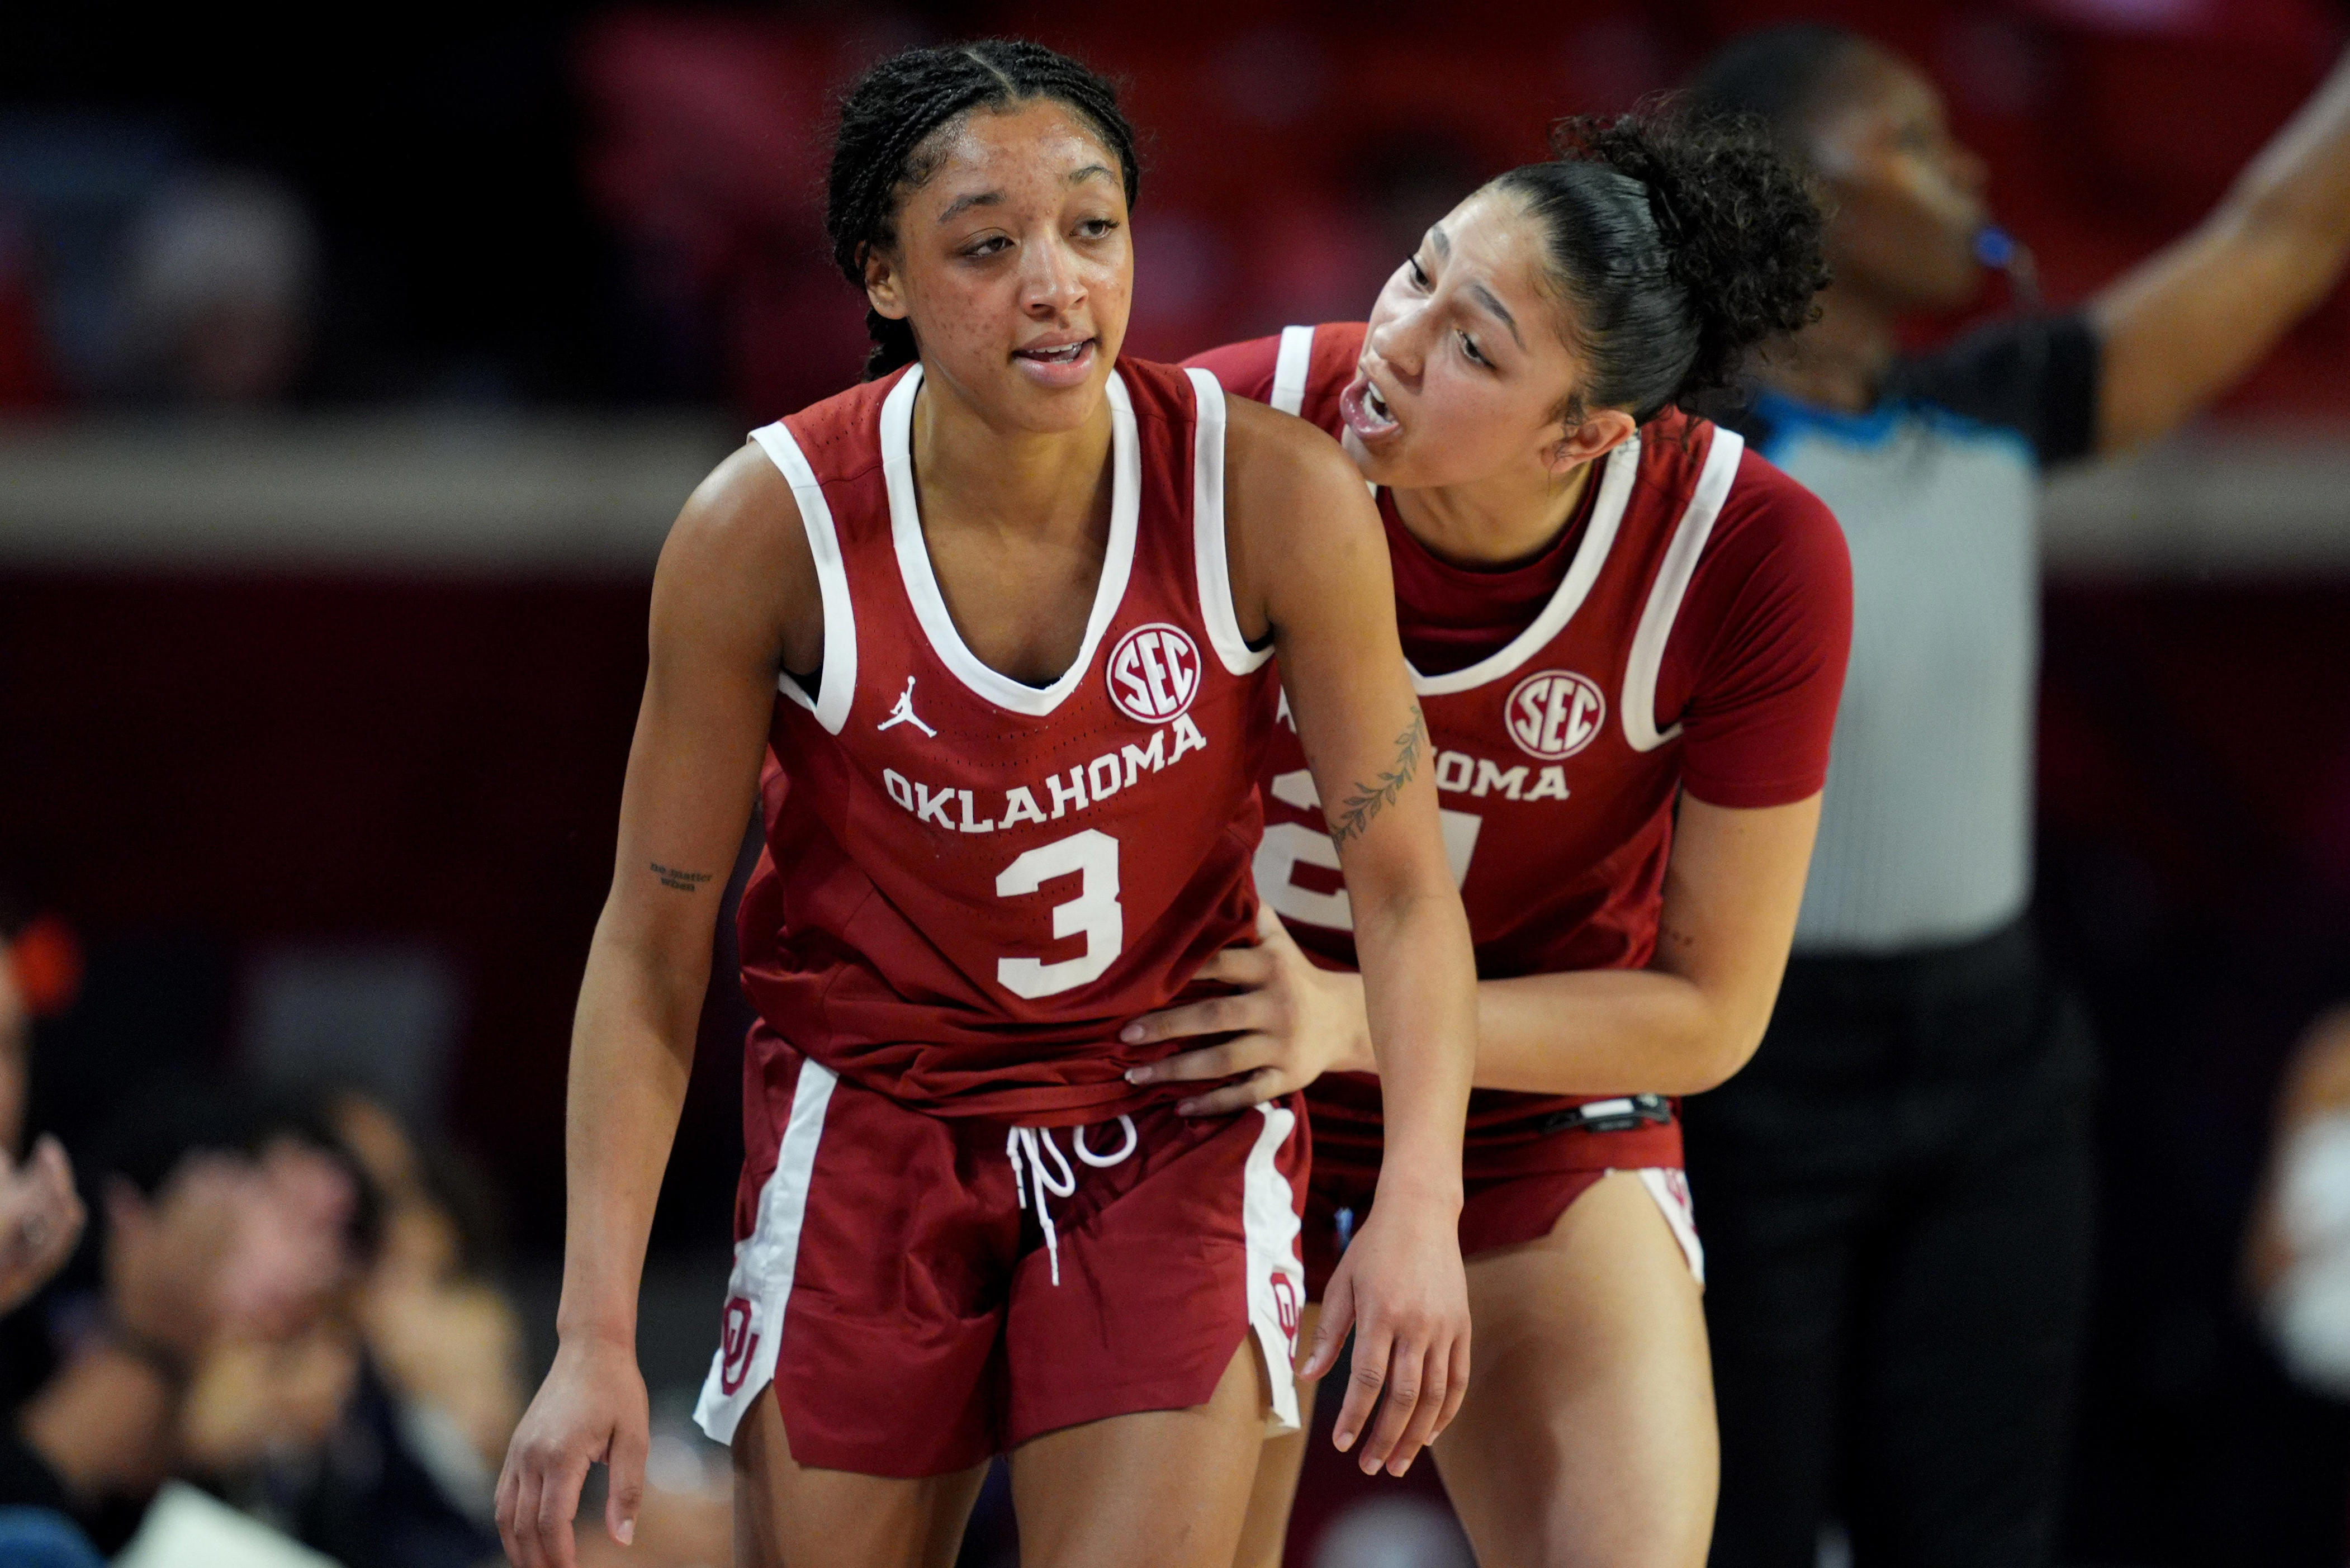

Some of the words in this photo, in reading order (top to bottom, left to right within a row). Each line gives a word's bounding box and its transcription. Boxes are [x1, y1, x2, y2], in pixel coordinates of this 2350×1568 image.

[1115, 631, 1190, 716] SEC
[1515, 677, 1595, 752] SEC
[883, 713, 1206, 833] OKLAHOMA
[996, 828, 1122, 999] 3
